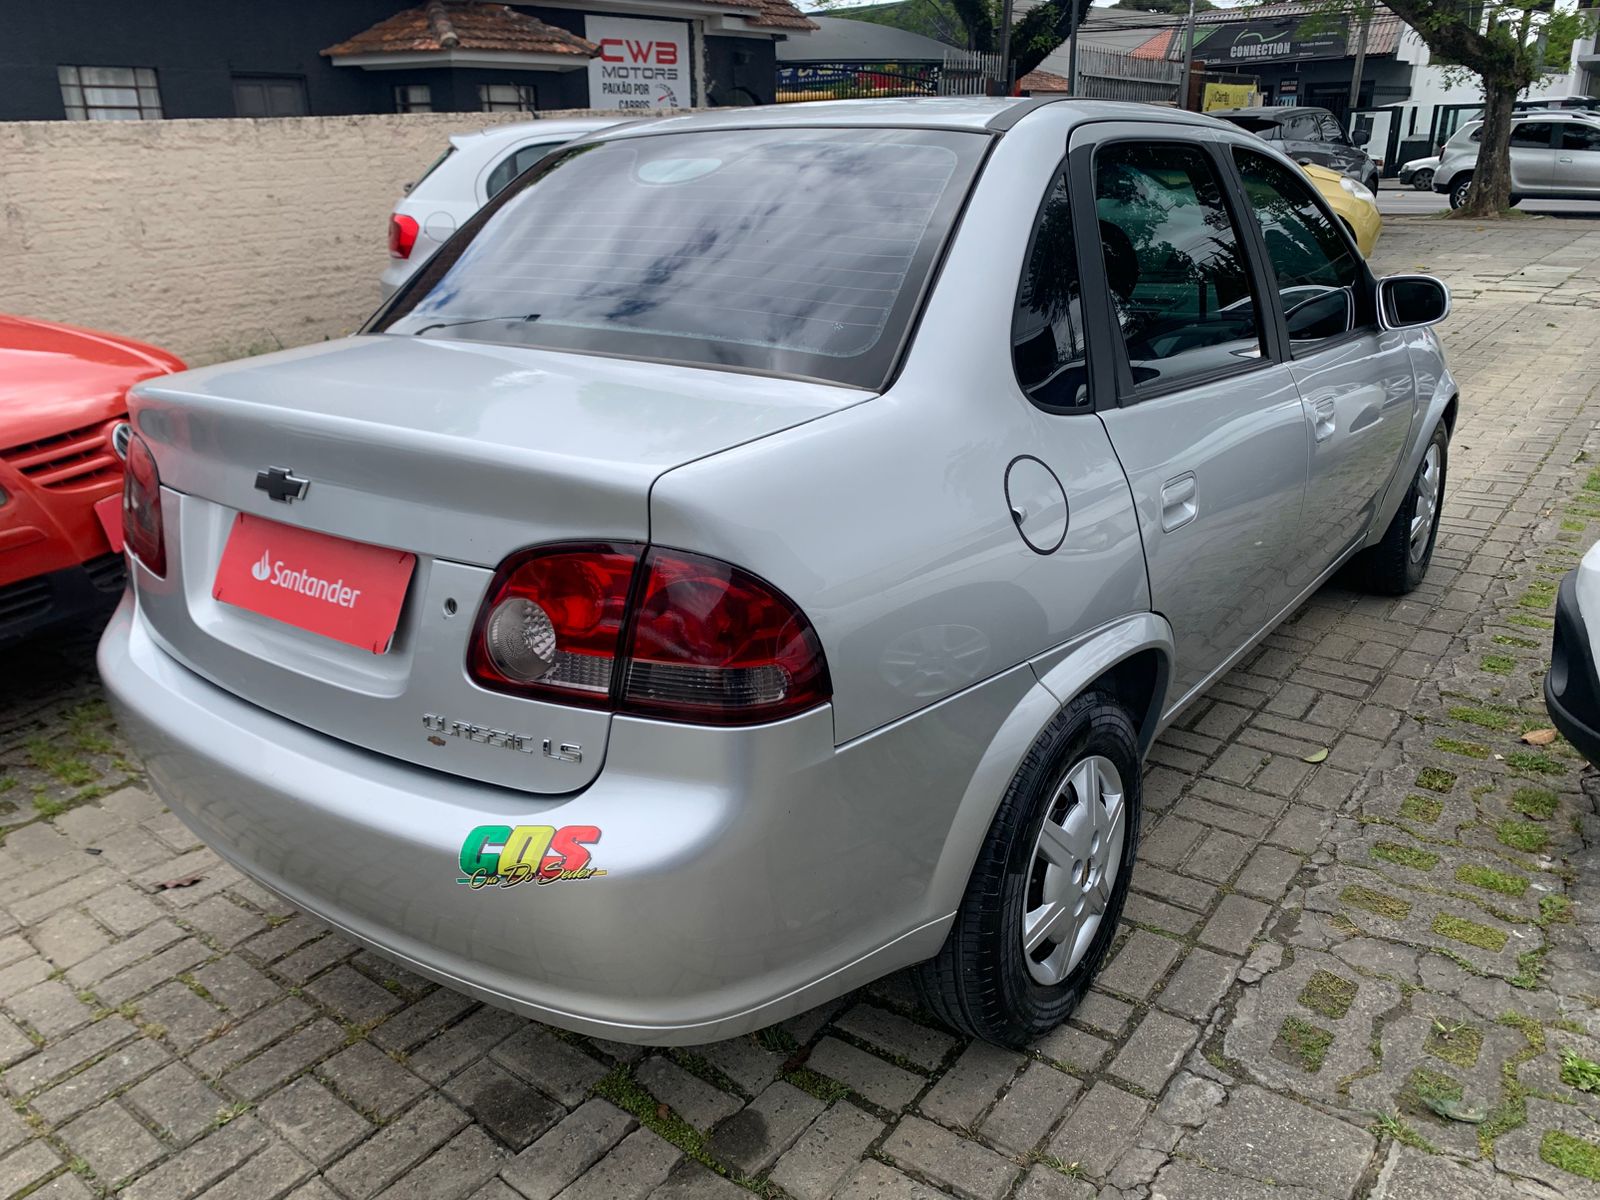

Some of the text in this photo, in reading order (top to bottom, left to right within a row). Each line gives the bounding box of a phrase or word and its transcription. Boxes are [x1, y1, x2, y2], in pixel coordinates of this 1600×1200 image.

[599, 38, 678, 65] CWB
[1230, 42, 1291, 58] CONNECTION
[602, 66, 678, 80] MOTORS
[602, 81, 650, 95] PAIXÃO POR
[270, 560, 361, 609] Santander
[422, 713, 582, 763] CLASSIC LS
[499, 862, 534, 888] Do
[536, 860, 596, 887] Sedex
